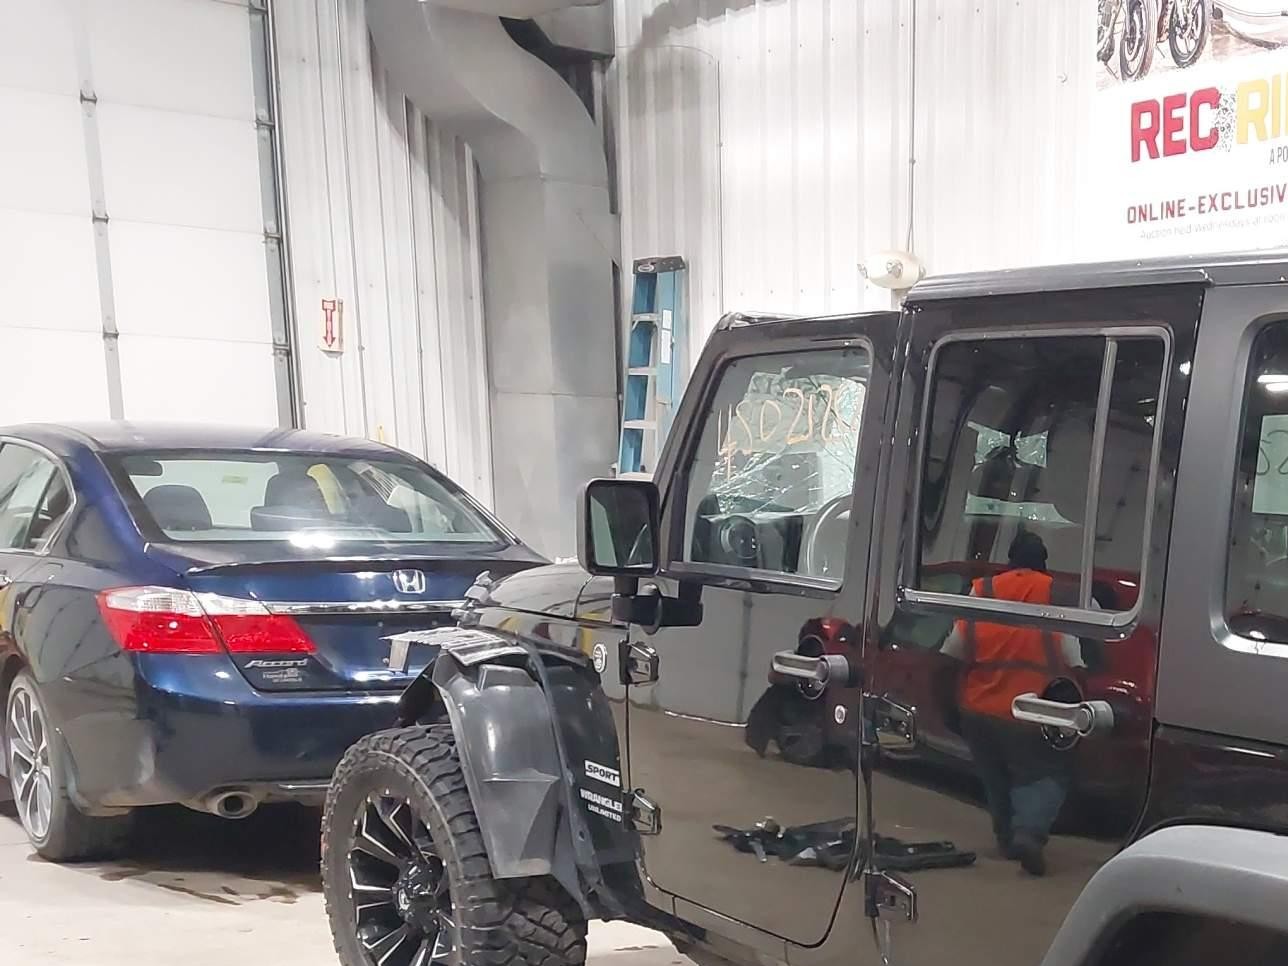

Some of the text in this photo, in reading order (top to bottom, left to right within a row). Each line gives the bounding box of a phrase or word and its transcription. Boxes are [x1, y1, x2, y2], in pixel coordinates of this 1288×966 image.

[1131, 87, 1221, 162] REC
[1269, 148, 1275, 165] A
[244, 658, 309, 668] Accord
[587, 764, 617, 782] SPORT
[580, 788, 622, 812] WRANGLE
[587, 803, 622, 822] UNLIMITED
